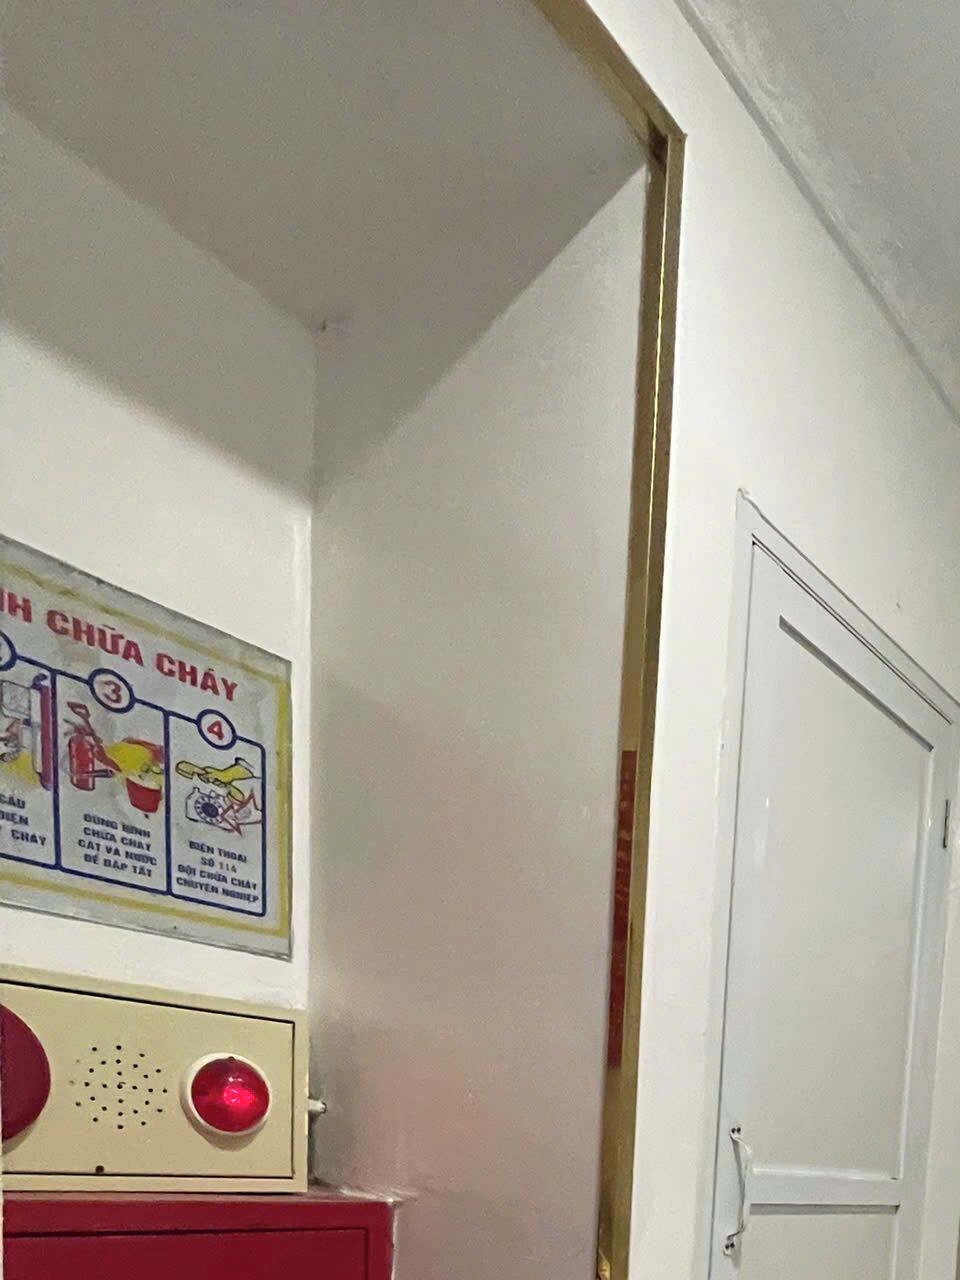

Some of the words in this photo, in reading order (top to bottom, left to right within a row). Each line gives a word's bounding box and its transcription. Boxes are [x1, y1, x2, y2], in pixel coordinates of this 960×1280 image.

[103, 680, 123, 704] 3
[206, 720, 225, 741] 4
[218, 861, 238, 874] 114
